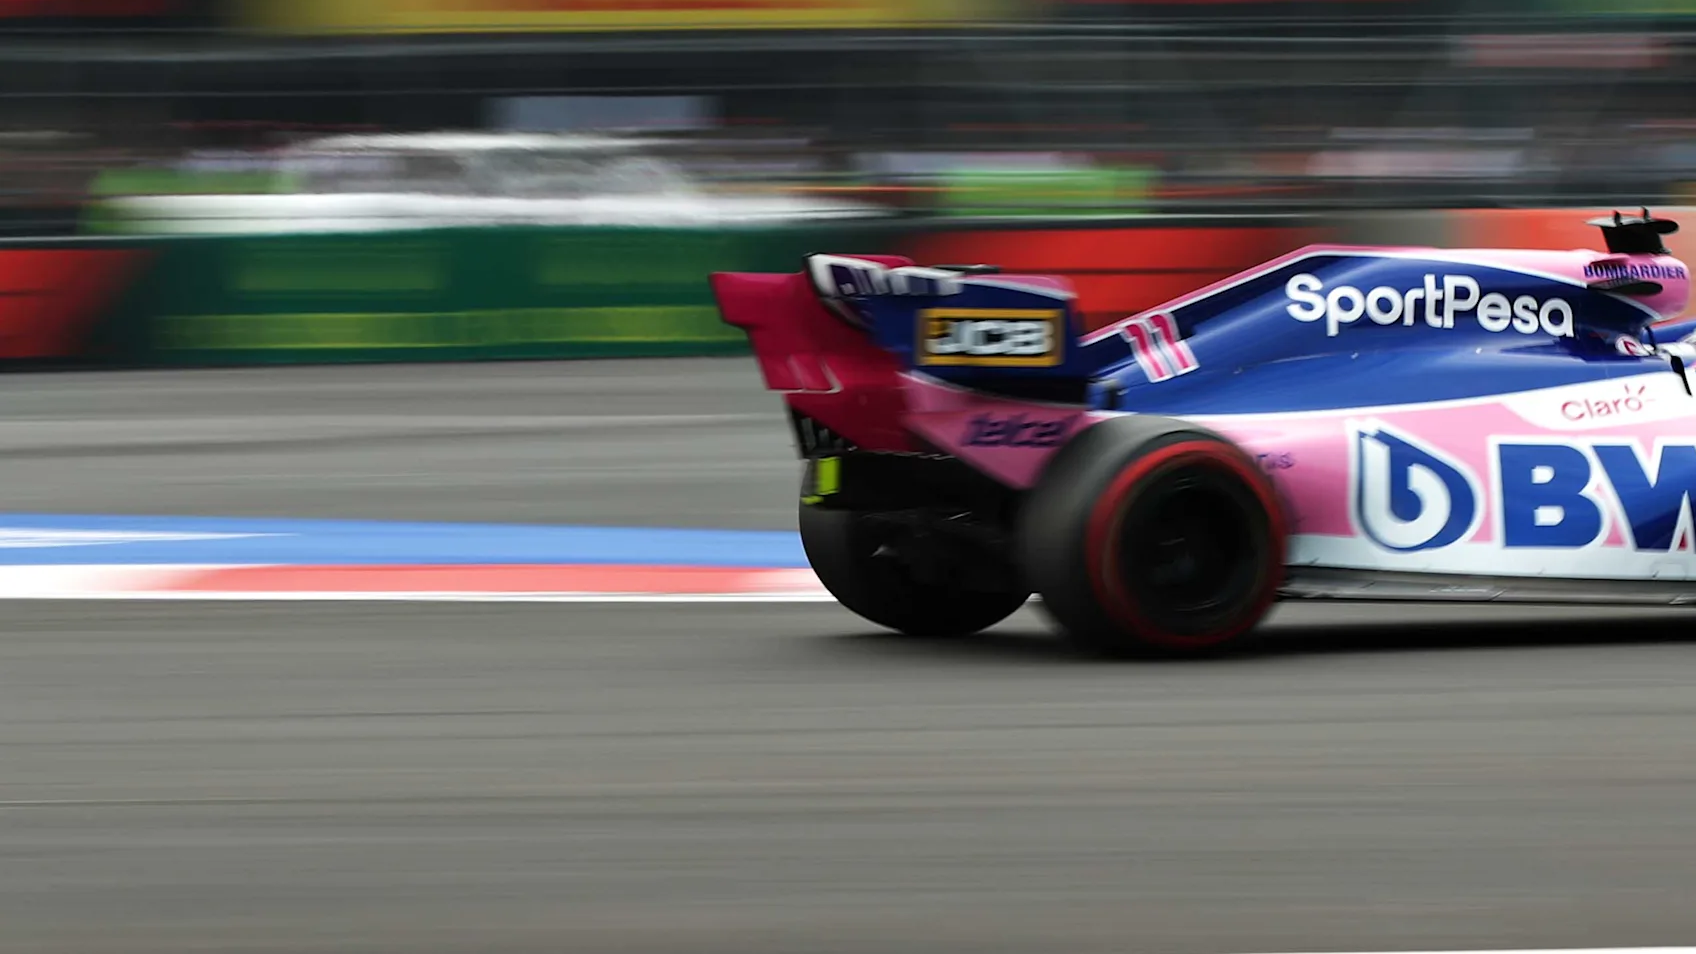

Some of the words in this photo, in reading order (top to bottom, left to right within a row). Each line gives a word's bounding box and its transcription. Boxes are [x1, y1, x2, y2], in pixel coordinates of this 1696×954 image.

[1583, 264, 1686, 280] BOMBARDIER
[1286, 274, 1575, 338] SportPesa
[925, 319, 1053, 355] JCB
[1121, 312, 1198, 382] 11
[1561, 391, 1644, 421] Claro
